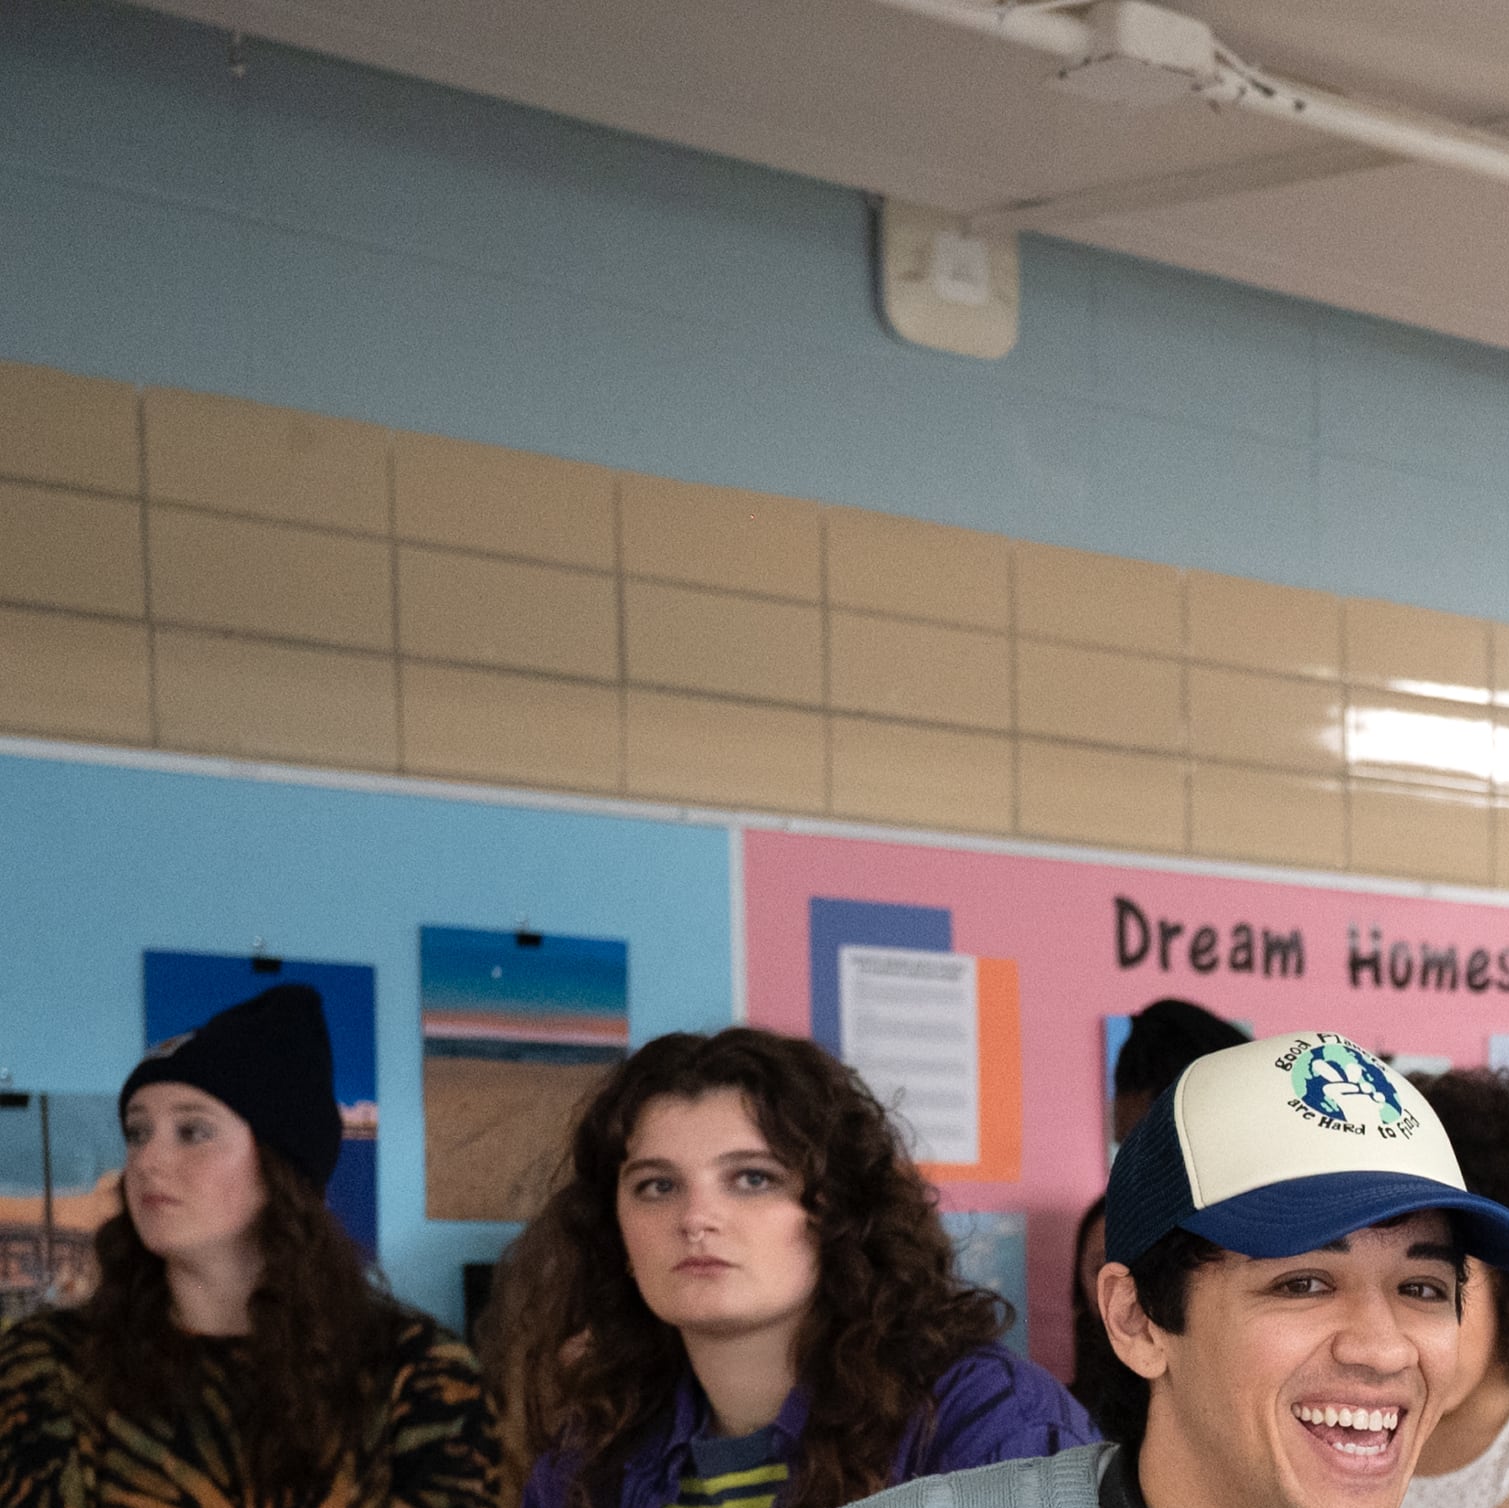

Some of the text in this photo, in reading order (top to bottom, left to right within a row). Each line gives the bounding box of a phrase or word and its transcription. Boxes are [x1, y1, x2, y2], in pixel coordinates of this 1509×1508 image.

[1113, 897, 1305, 979] Dream
[1287, 1098, 1316, 1120] are
[1377, 1125, 1398, 1140] to
